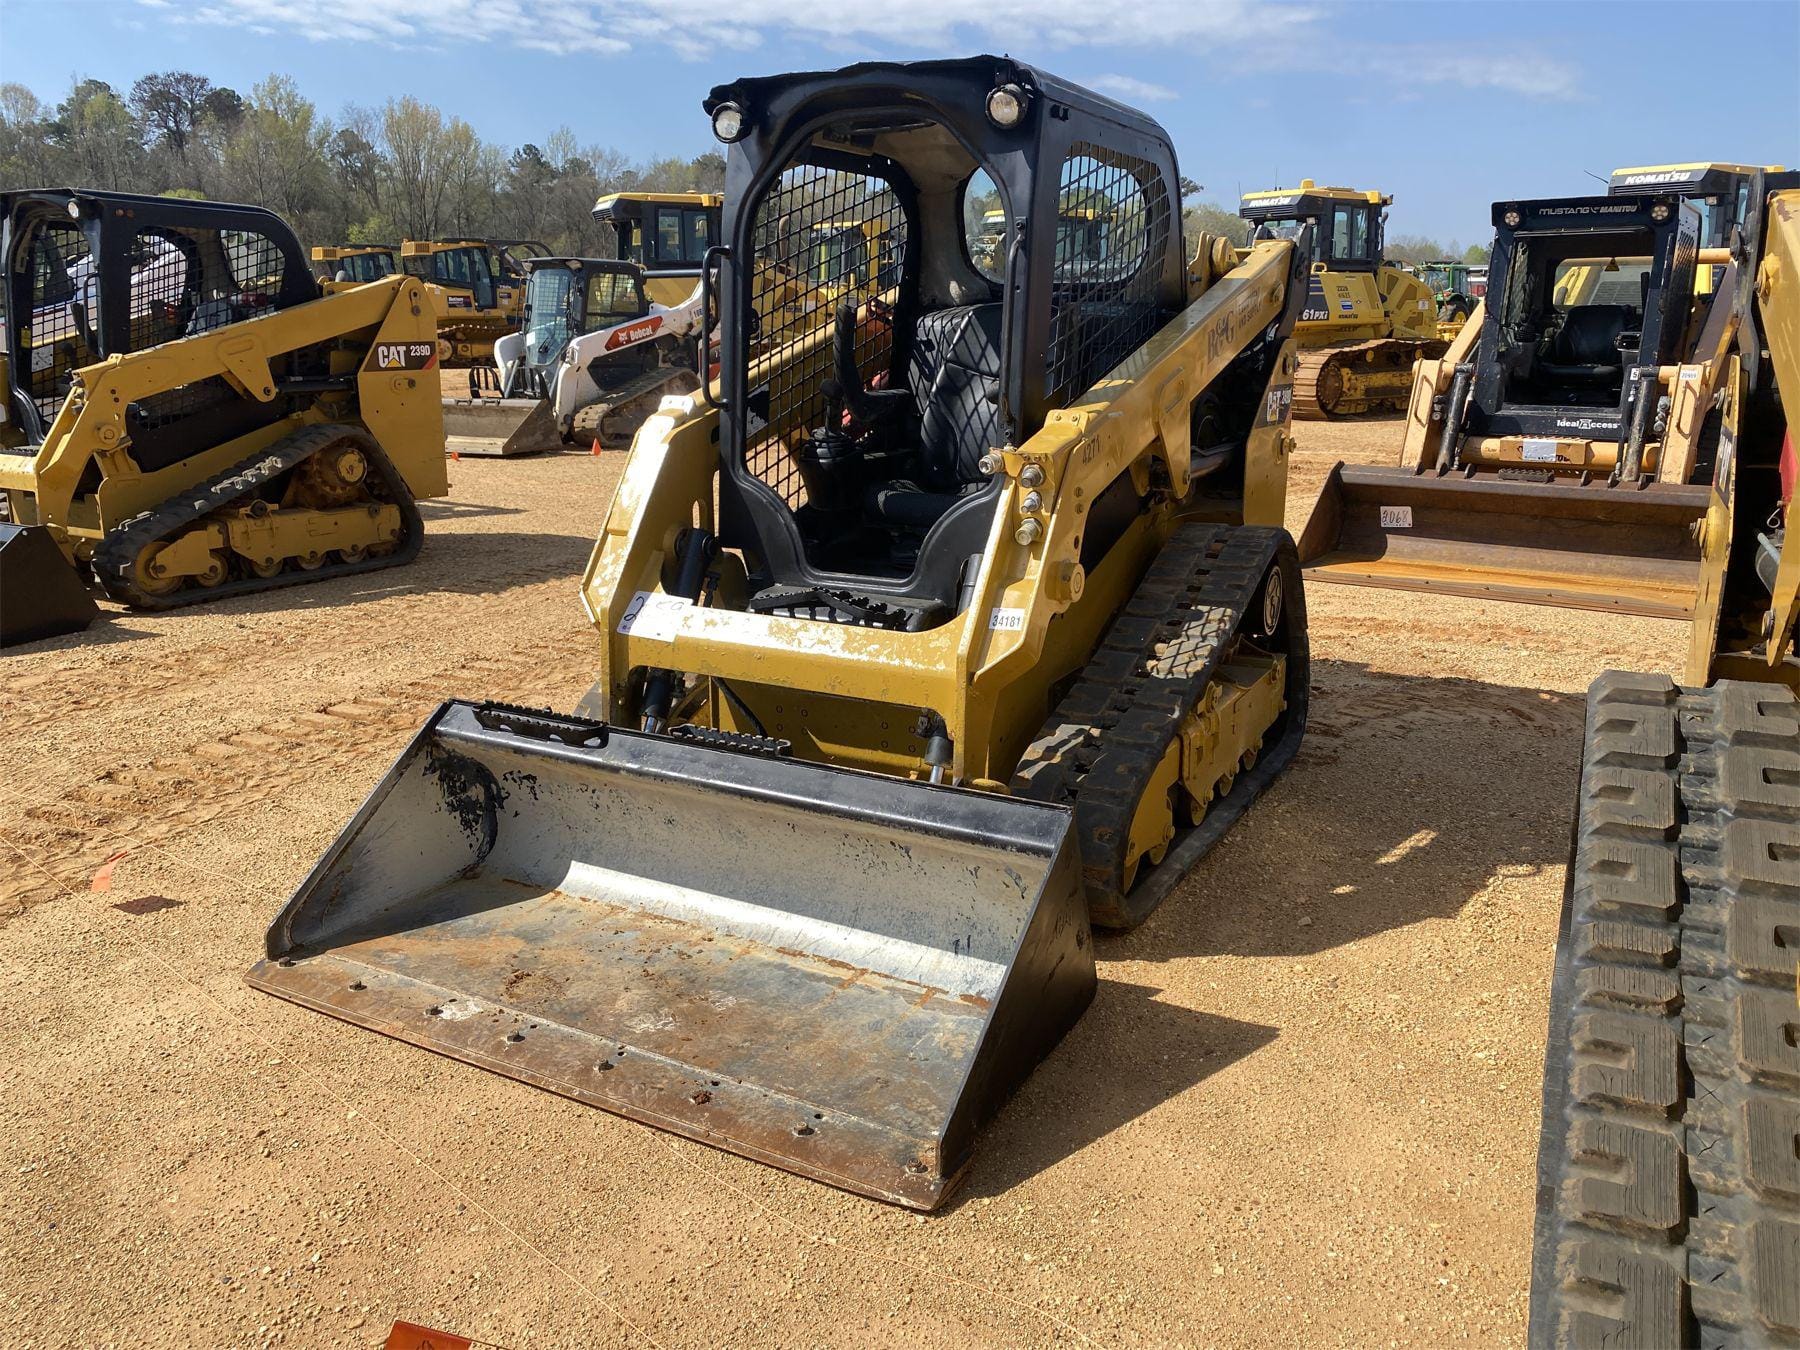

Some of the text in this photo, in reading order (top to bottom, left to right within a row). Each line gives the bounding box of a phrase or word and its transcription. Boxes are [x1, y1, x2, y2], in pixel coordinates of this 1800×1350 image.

[1625, 171, 1691, 185] KOMATSU
[1538, 205, 1638, 216] MUSTANG MANITOU
[629, 325, 653, 341] Bobcat
[377, 344, 431, 368] CAT 239D
[1082, 435, 1101, 465] 4271
[992, 615, 1021, 628] 34181
